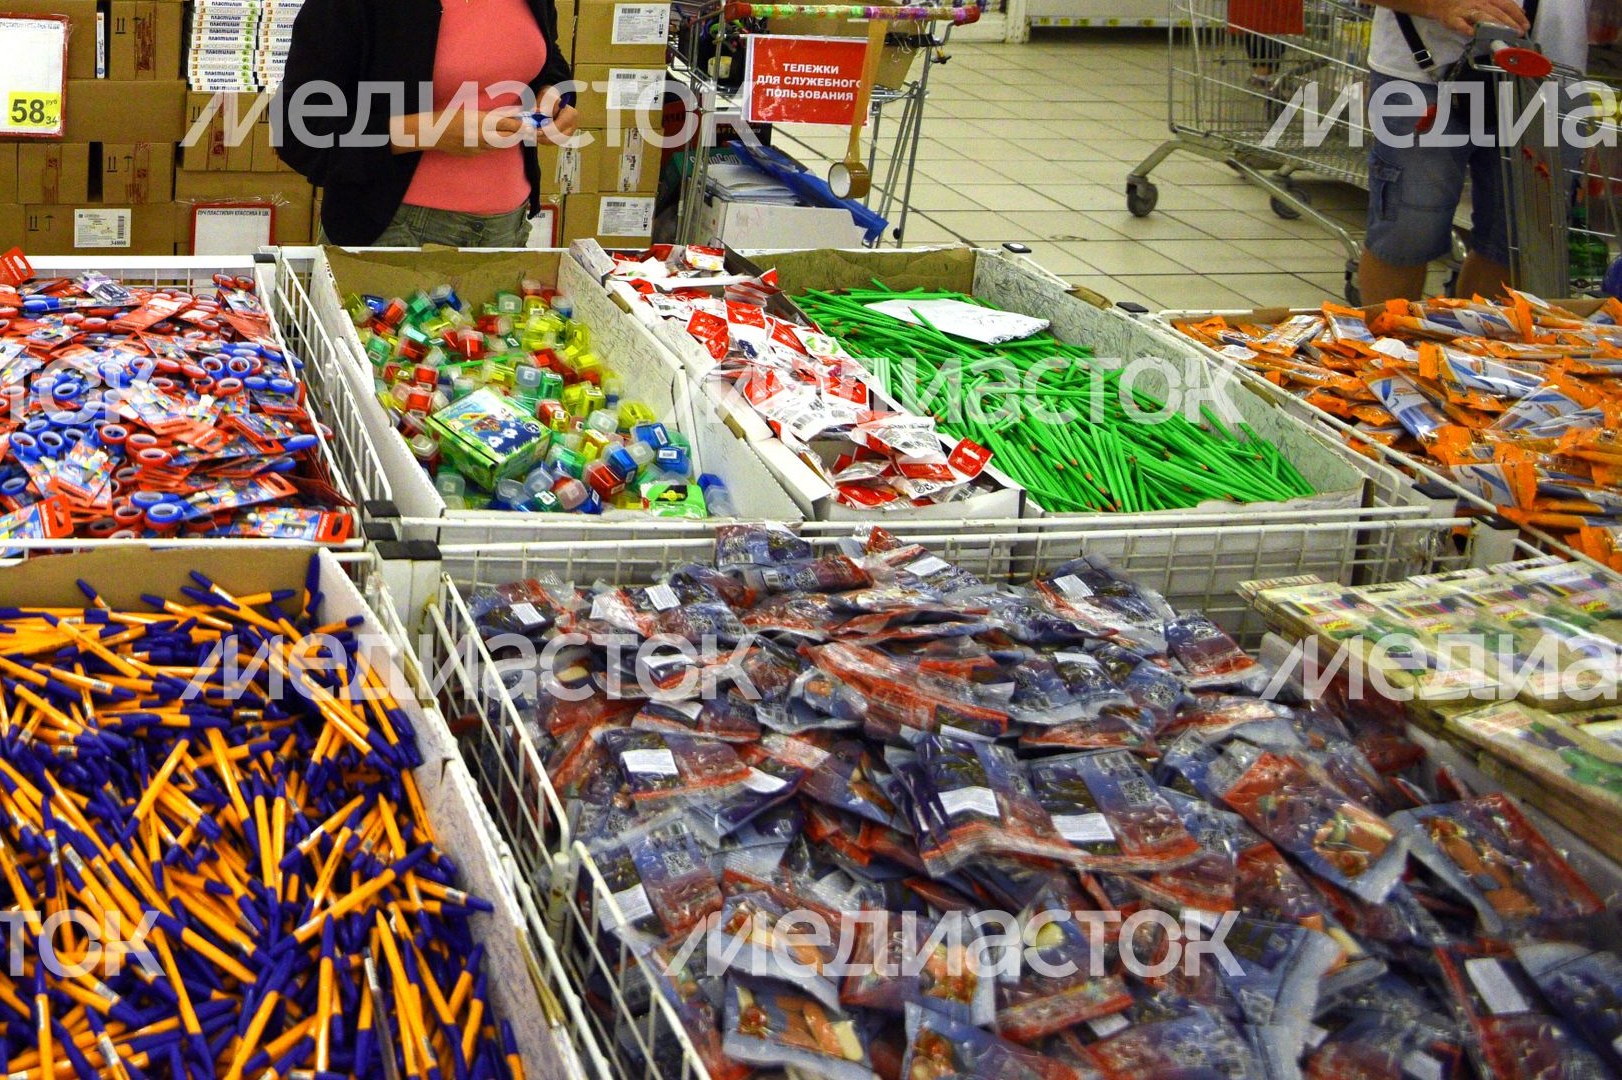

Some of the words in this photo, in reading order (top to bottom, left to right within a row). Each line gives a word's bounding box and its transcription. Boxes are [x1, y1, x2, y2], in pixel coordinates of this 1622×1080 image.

[783, 63, 839, 75] ТЕЛЕЖКИ
[756, 75, 781, 86] ДЛЯ
[784, 76, 861, 88] СЛУЖЕБНОГО
[766, 88, 854, 101] ПОЛЬЗОВАНИЯ
[11, 99, 45, 124] 58
[46, 116, 58, 125] 34
